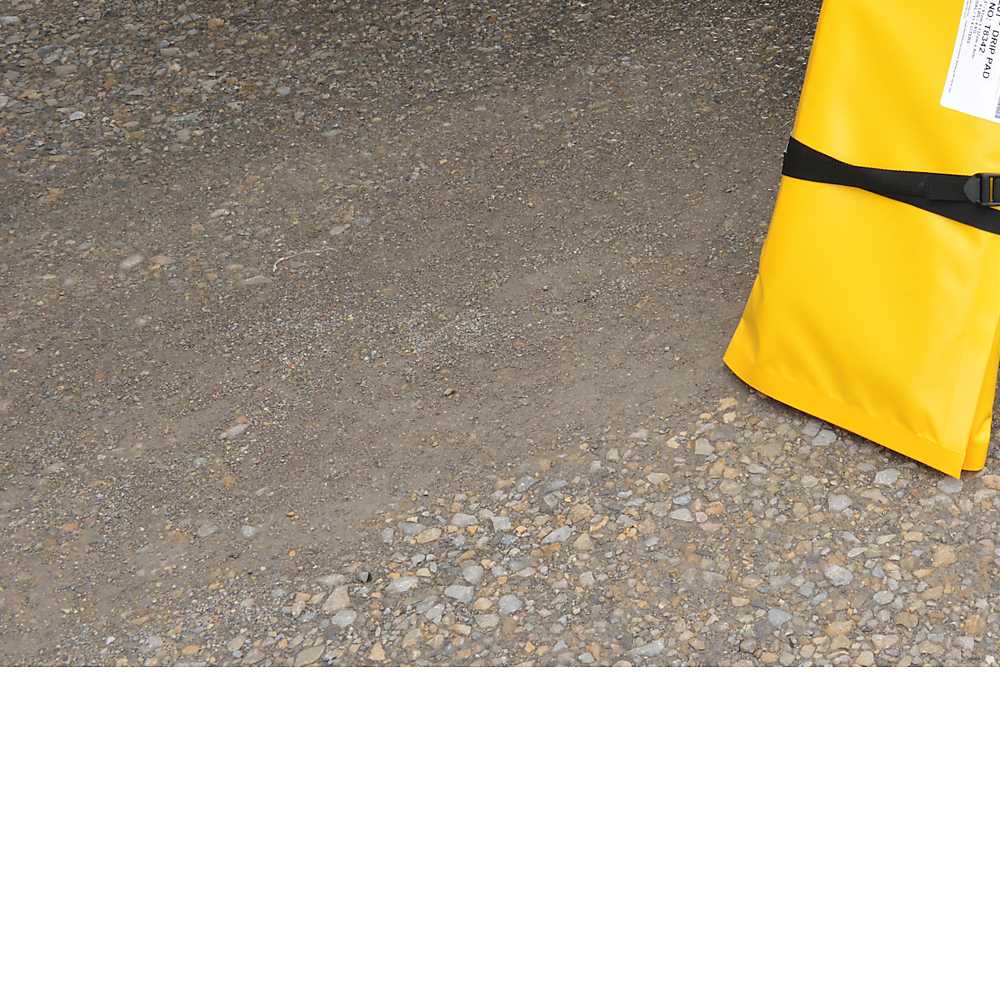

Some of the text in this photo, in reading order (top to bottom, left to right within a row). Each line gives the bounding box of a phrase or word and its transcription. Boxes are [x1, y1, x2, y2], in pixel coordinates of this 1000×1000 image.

[985, 1, 996, 21] NO:
[977, 23, 991, 53] T8342
[989, 29, 1000, 55] DRIP
[981, 56, 993, 79] PAD
